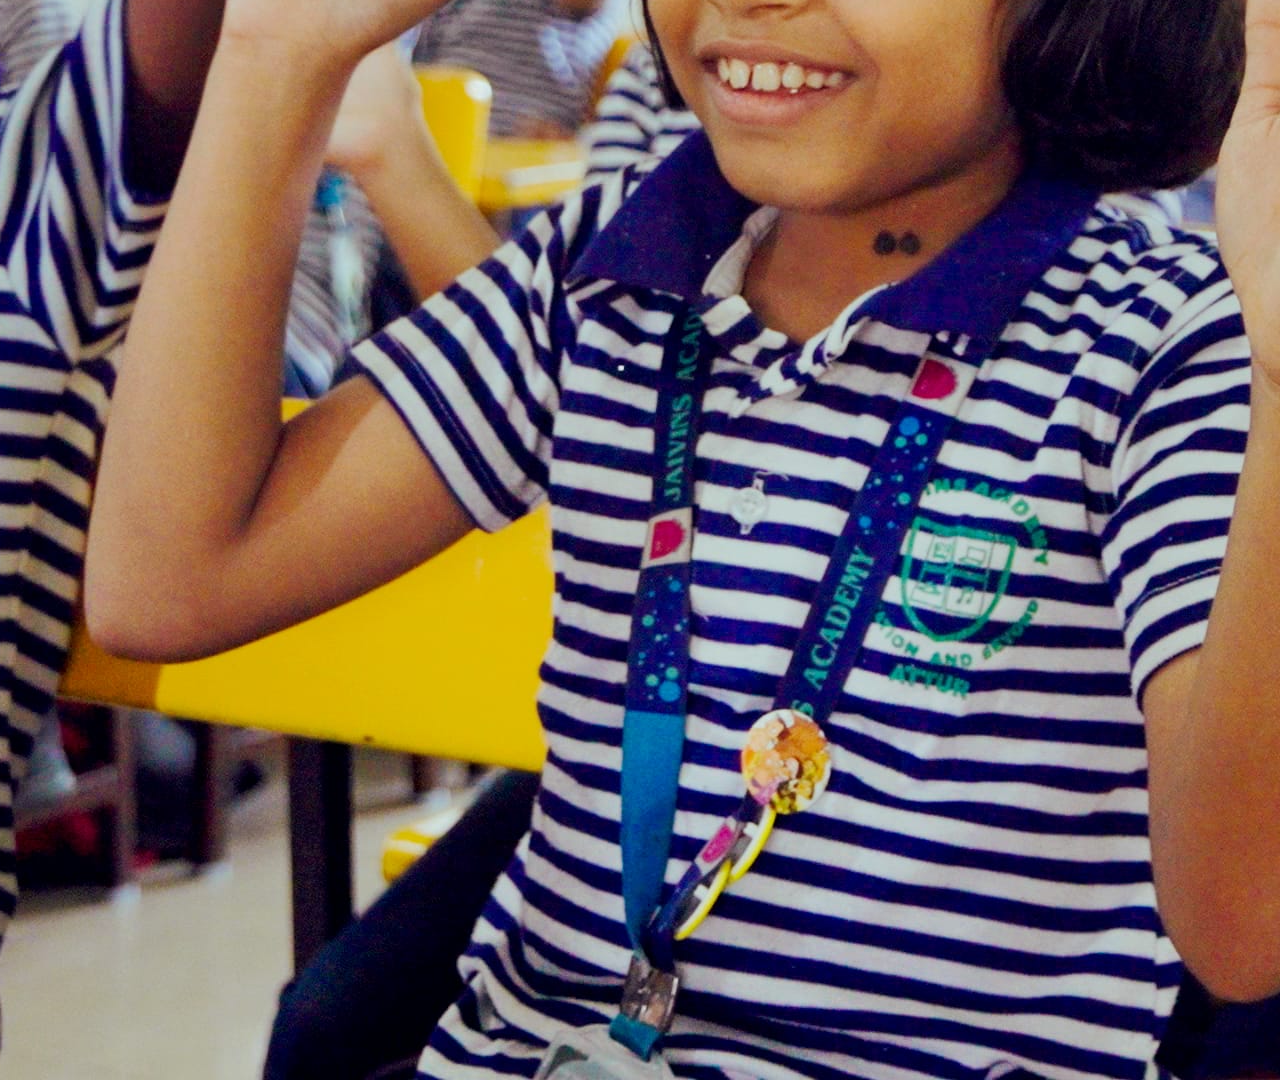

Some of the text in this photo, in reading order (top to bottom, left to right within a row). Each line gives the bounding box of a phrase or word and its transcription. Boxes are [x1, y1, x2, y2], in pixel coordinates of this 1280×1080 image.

[664, 393, 693, 501] JAIVINS
[803, 544, 875, 691] ACADEMY
[888, 663, 970, 700] ATTUR
[929, 652, 972, 668] AND
